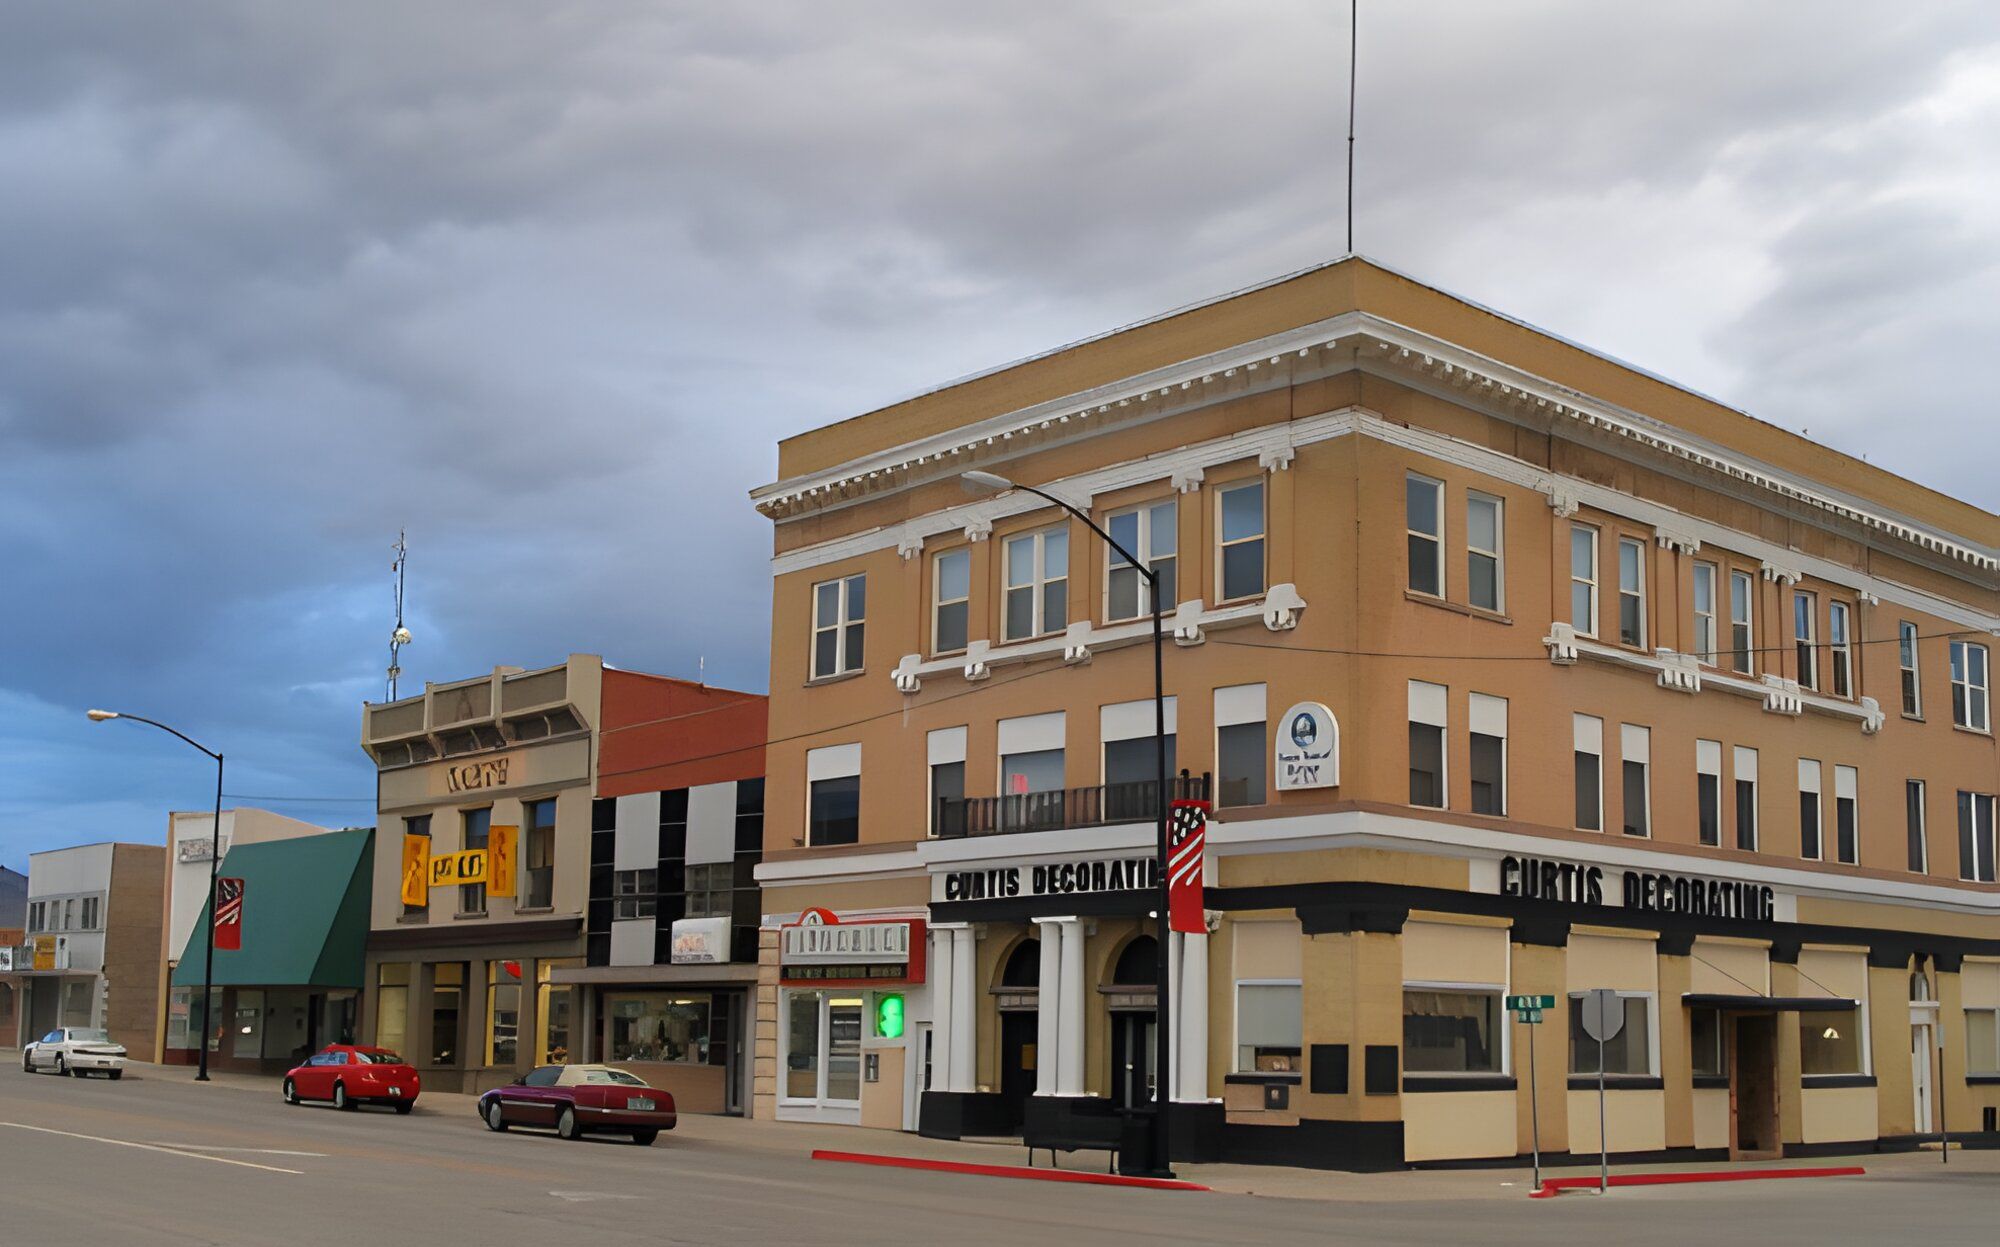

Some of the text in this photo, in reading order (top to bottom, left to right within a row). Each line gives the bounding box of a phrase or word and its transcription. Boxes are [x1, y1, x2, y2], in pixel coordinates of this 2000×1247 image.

[946, 858, 1159, 901] CURTIS DECORATI
[1501, 855, 1774, 921] CURTIS DECORATING
